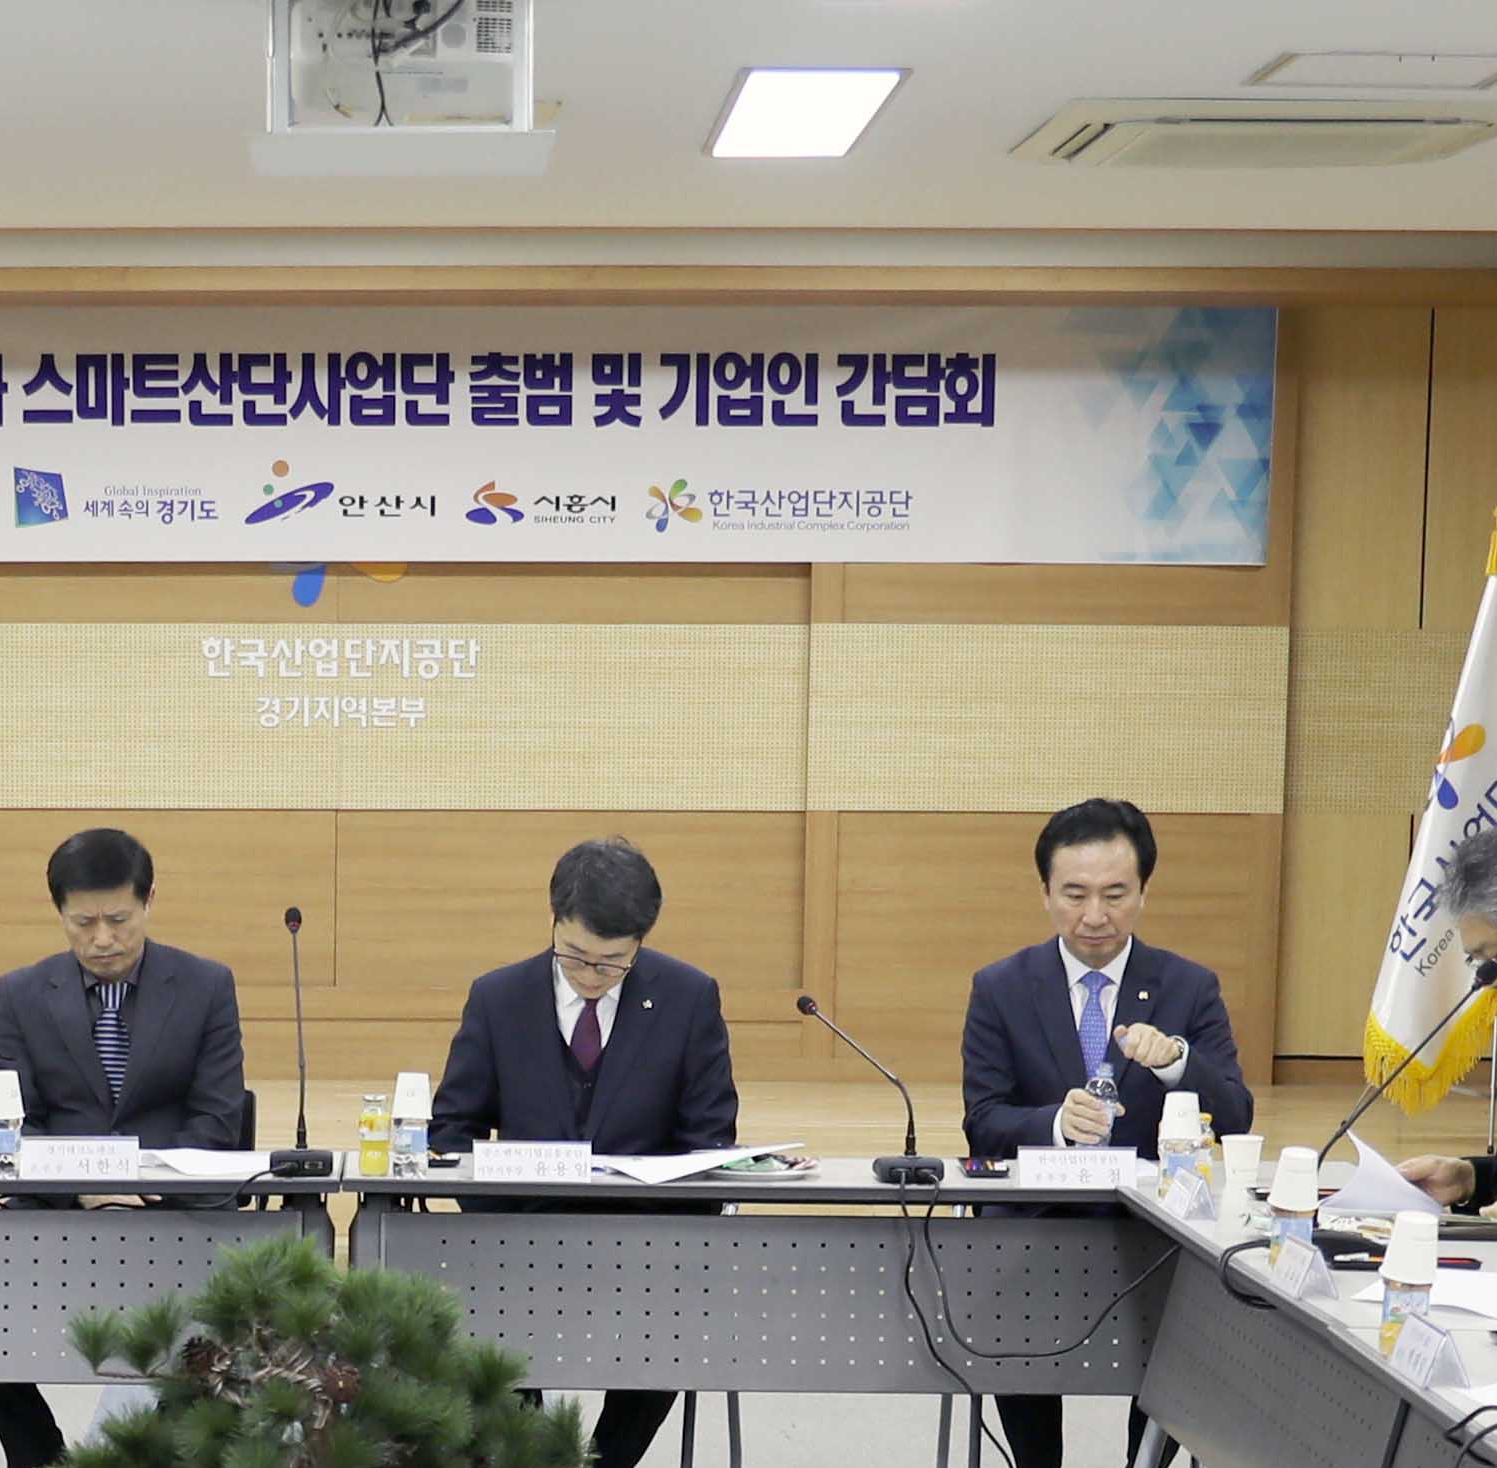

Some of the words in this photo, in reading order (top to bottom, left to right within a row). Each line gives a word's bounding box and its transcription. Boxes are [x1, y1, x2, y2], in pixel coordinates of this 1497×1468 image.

[22, 351, 455, 427] 스마트산단사업단
[469, 352, 573, 426] 출범
[591, 352, 643, 427] 및
[659, 351, 819, 427] 기업인
[836, 353, 996, 427] 간담회
[104, 486, 139, 497] Global
[143, 486, 202, 499] Inspiration
[533, 494, 616, 513] 시흥시
[708, 489, 914, 518] 한국산업단지공단
[83, 500, 115, 518] 세계
[117, 500, 150, 519] 속의
[156, 499, 219, 525] 경기도
[338, 495, 436, 518] 안산시
[533, 515, 584, 524] SIHEUNG
[589, 515, 616, 524] CITY
[713, 521, 745, 530] Korea
[748, 521, 795, 530] Industrial
[797, 521, 845, 533] Complex
[847, 521, 911, 533] Corporation
[201, 636, 481, 680] 한국산업단지공단
[257, 696, 427, 729] 경기지역본부
[1415, 929, 1455, 978] Korea
